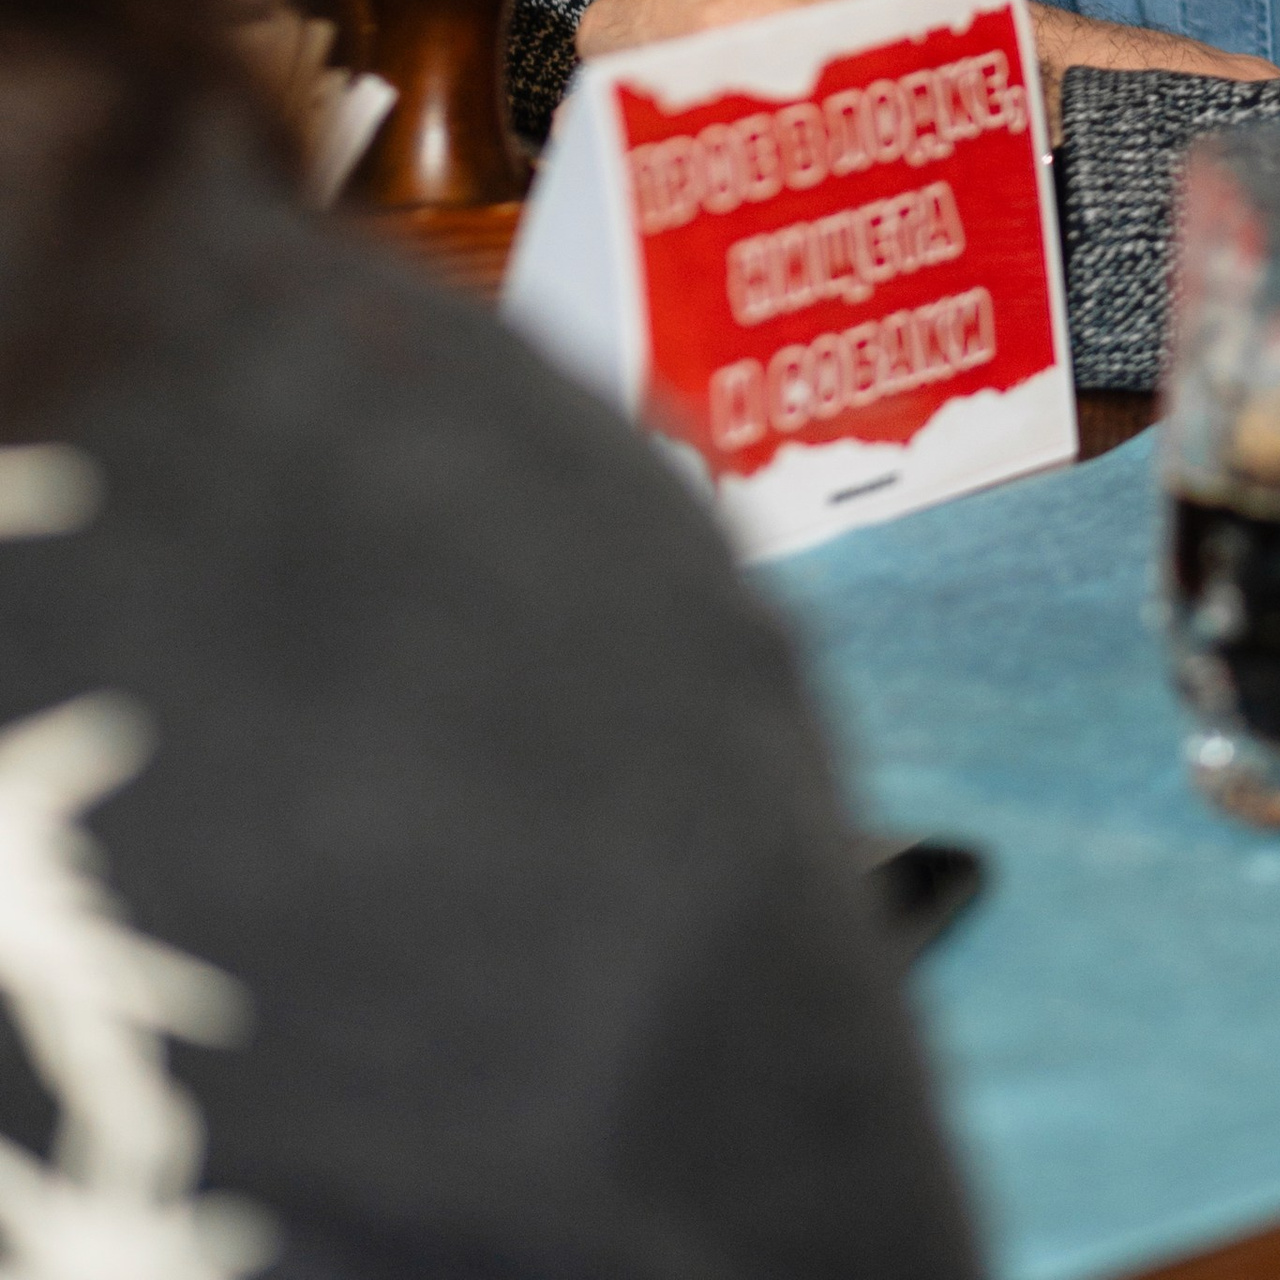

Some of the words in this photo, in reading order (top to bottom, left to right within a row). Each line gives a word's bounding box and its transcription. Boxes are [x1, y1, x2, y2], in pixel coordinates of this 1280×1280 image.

[823, 50, 1028, 175] ЛОДКЕ,
[728, 182, 964, 324] НИЩЕТА
[768, 288, 994, 432] СОБАКИ
